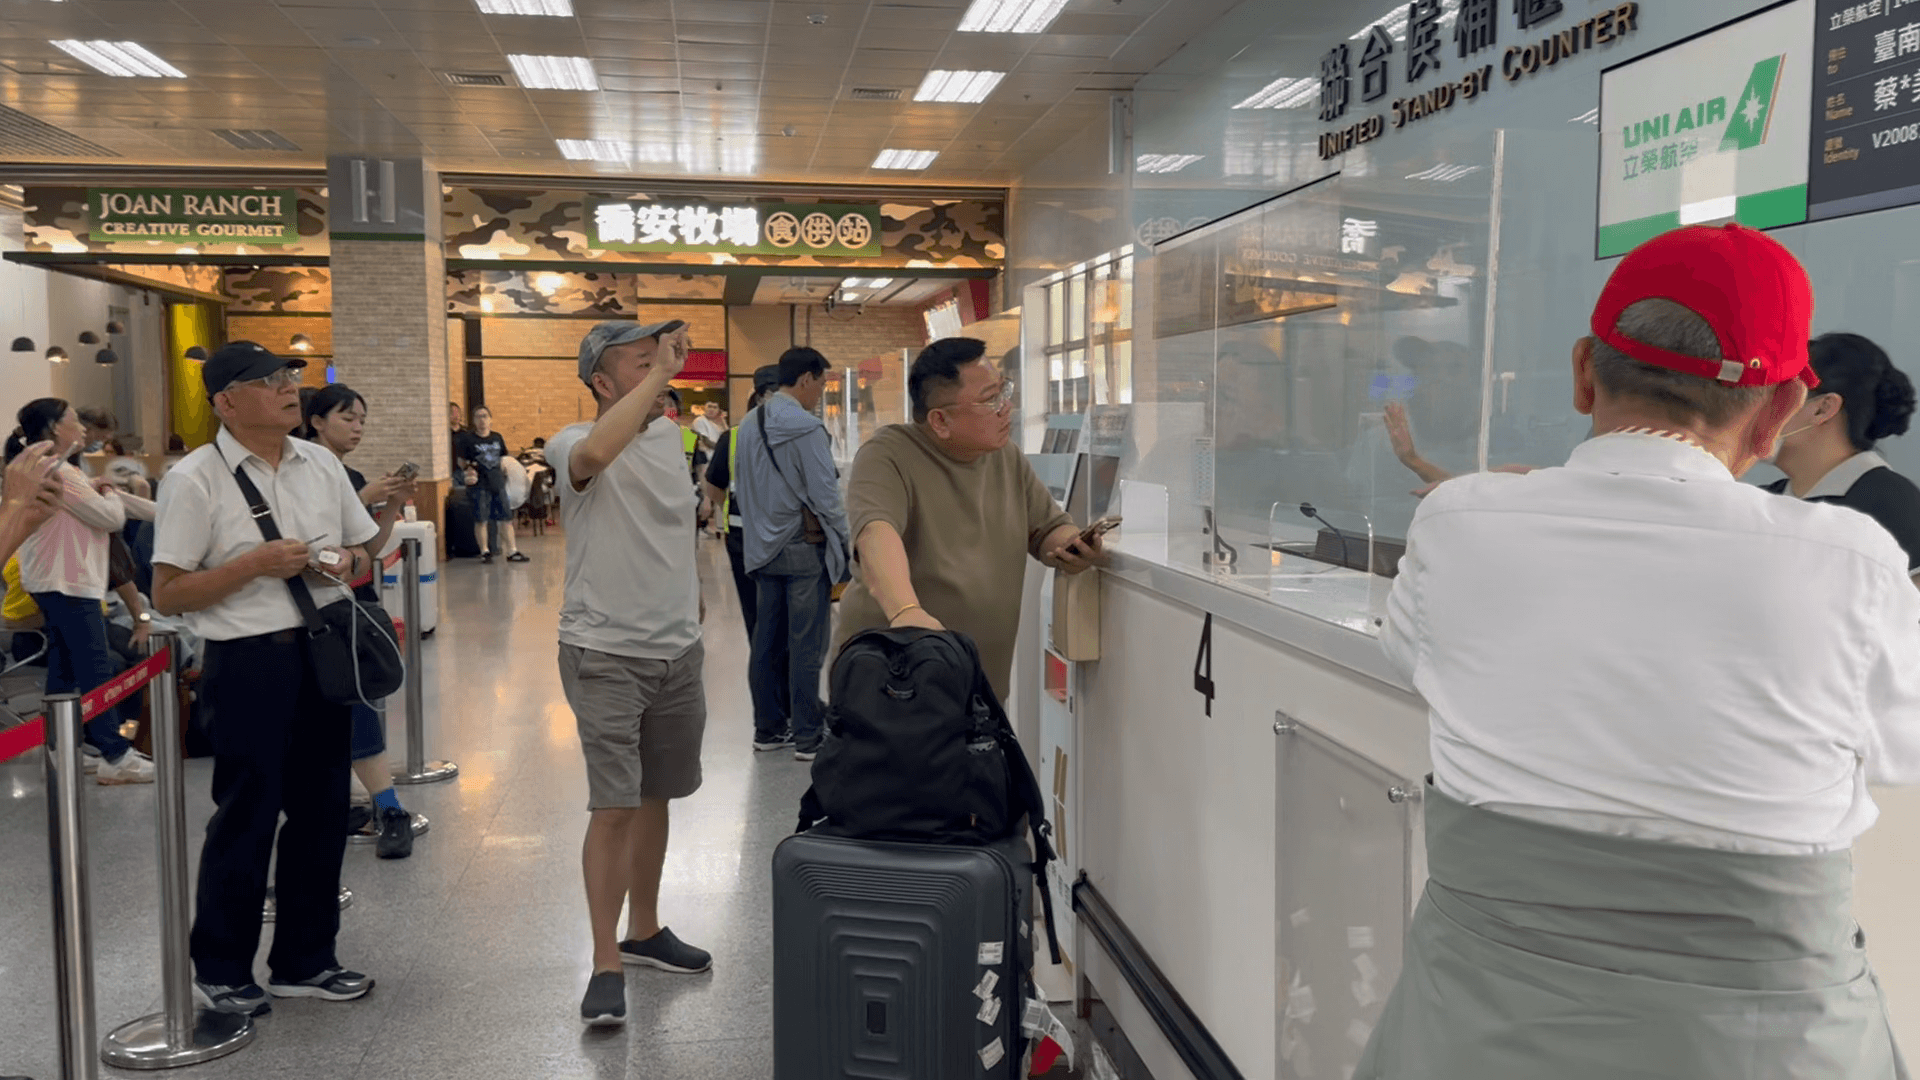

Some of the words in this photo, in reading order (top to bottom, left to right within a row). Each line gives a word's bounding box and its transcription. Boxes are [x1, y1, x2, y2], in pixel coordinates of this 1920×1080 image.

[1829, 0, 1882, 31] 立榮航空
[1318, 114, 1383, 160] UNIFIED
[1391, 65, 1493, 128] STAND-BY
[1502, 1, 1639, 81] COUNTER
[1623, 113, 1670, 149] UNI
[1674, 96, 1727, 134] AIR
[1872, 123, 1920, 149] V2008
[1623, 138, 1698, 181] 立榮航空
[98, 193, 172, 219] JOAN
[183, 195, 283, 217] RANCH
[102, 223, 190, 237] CREATIVE
[196, 224, 285, 238] GOURMET
